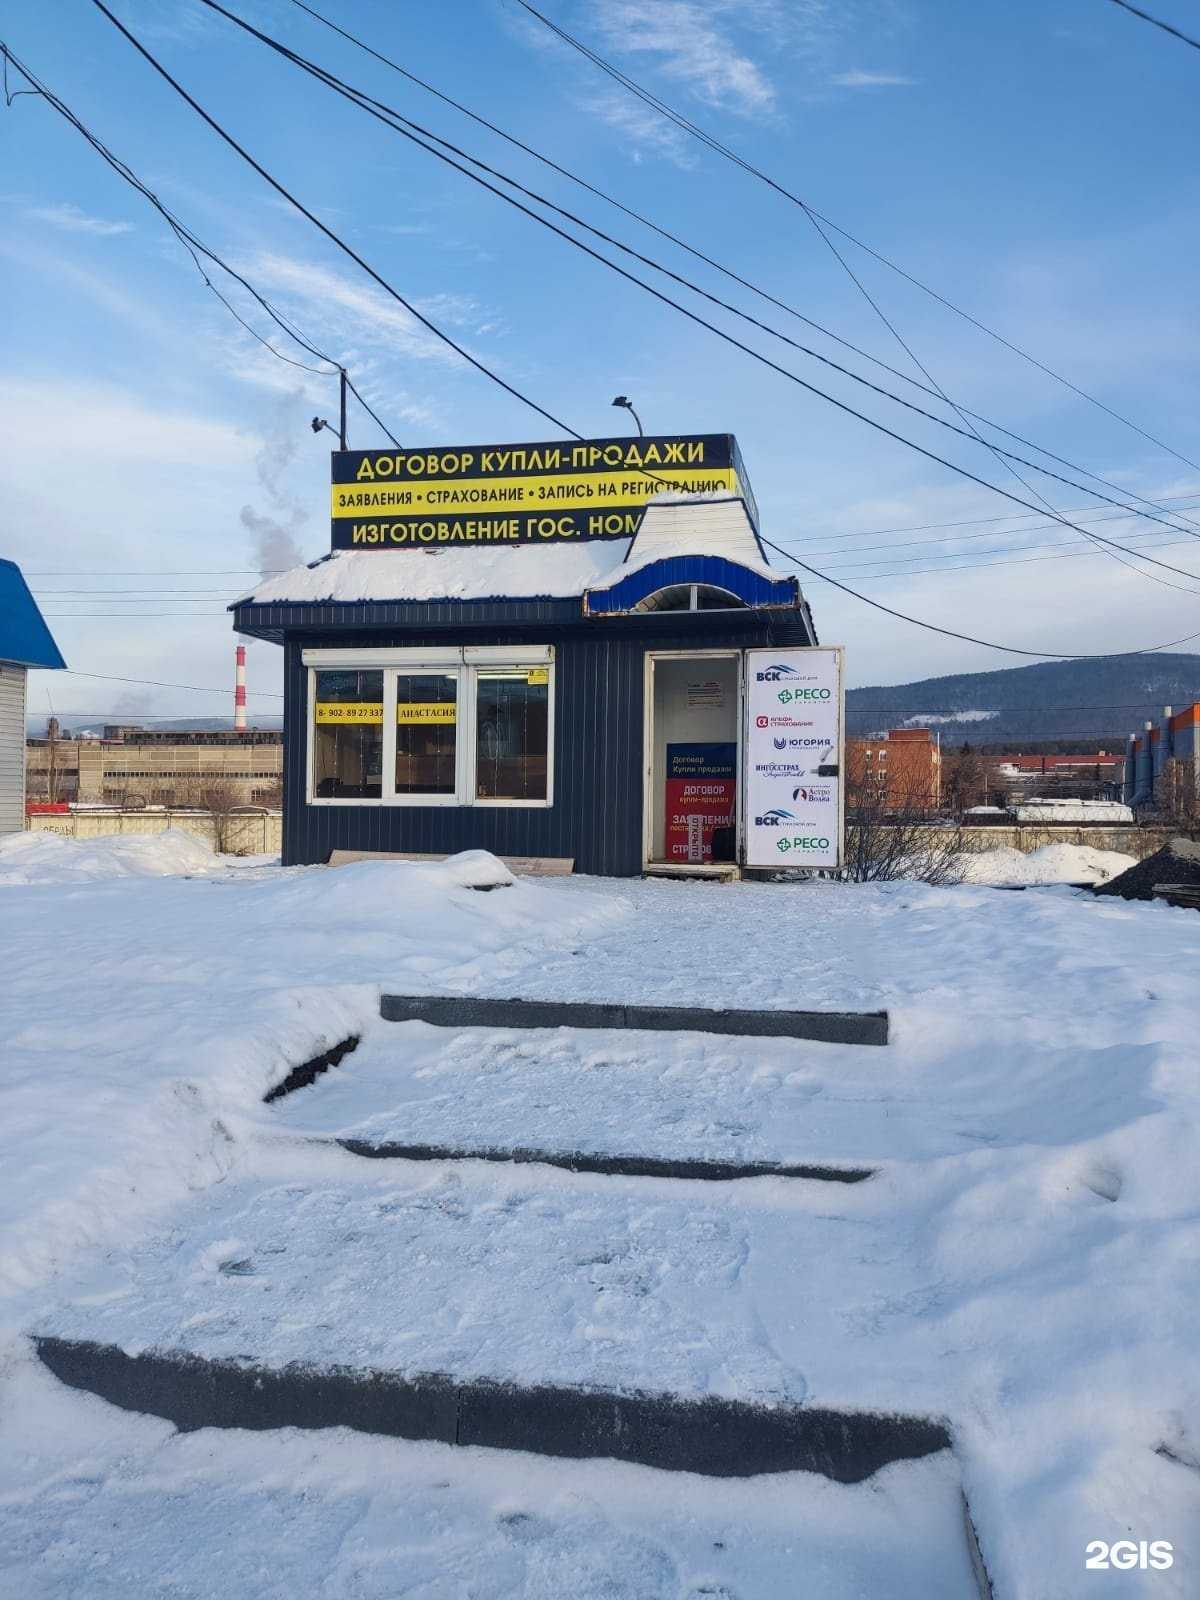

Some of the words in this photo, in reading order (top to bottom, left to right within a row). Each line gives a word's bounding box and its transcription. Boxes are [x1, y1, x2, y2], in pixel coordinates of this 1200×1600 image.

[356, 454, 474, 480] ДОГОВОР
[481, 442, 704, 472] КУПЛИ-ПРОДАЖИ
[339, 491, 412, 507] ЗАЯВЛЕНИЯ
[426, 487, 524, 504] СТРАХОВАНИЕ
[538, 484, 594, 499] ЗАПИСЬ
[598, 482, 617, 496] НА
[621, 479, 727, 496] РЕГИСТРАЦИЮ
[352, 519, 520, 544] ИЗГОТОВЛЕНИЕ
[526, 517, 581, 538] ГОС.
[756, 671, 781, 681] ВСК
[794, 688, 831, 699] РЕСО
[401, 709, 456, 718] АНАСТАСИЯ
[789, 738, 831, 746] ЮГОРИЯ
[683, 785, 725, 796] ДОГОВОР
[755, 816, 780, 826] ВСК
[793, 837, 830, 849] РЕСО
